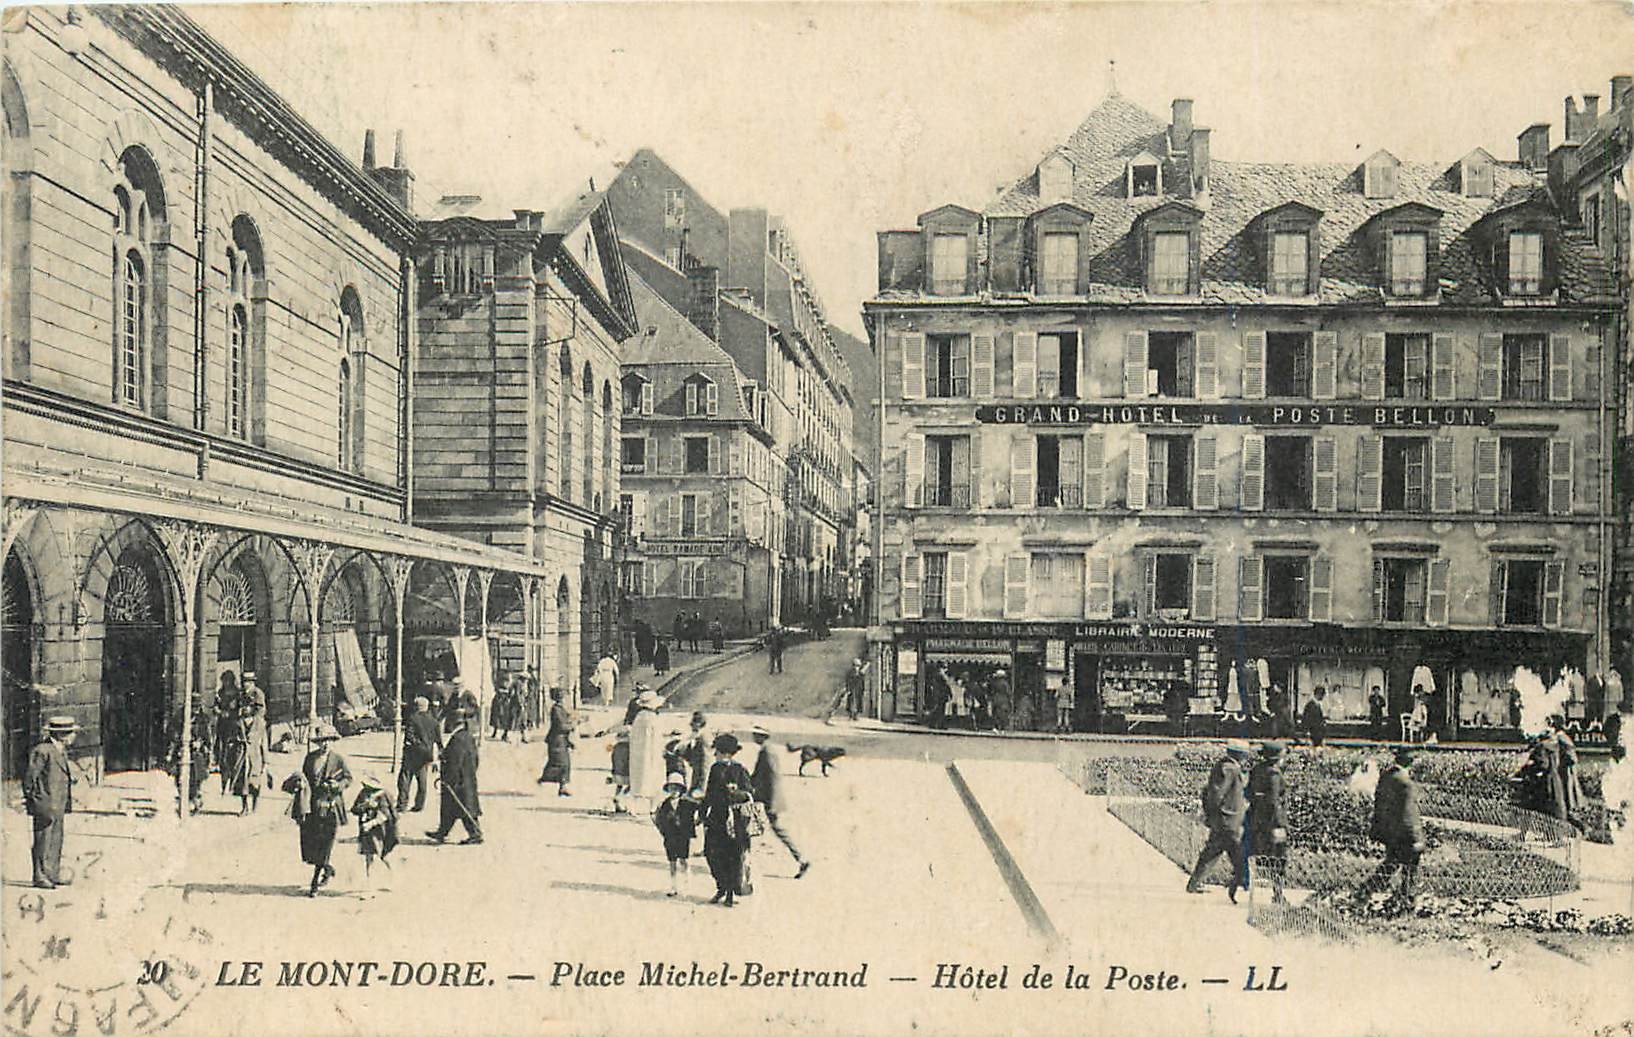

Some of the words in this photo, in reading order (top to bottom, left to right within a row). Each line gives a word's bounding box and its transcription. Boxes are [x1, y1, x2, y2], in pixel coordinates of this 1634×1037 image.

[1239, 415, 1252, 424] LA
[1273, 407, 1360, 425] POSTE
[1149, 627, 1215, 639] MODERNE
